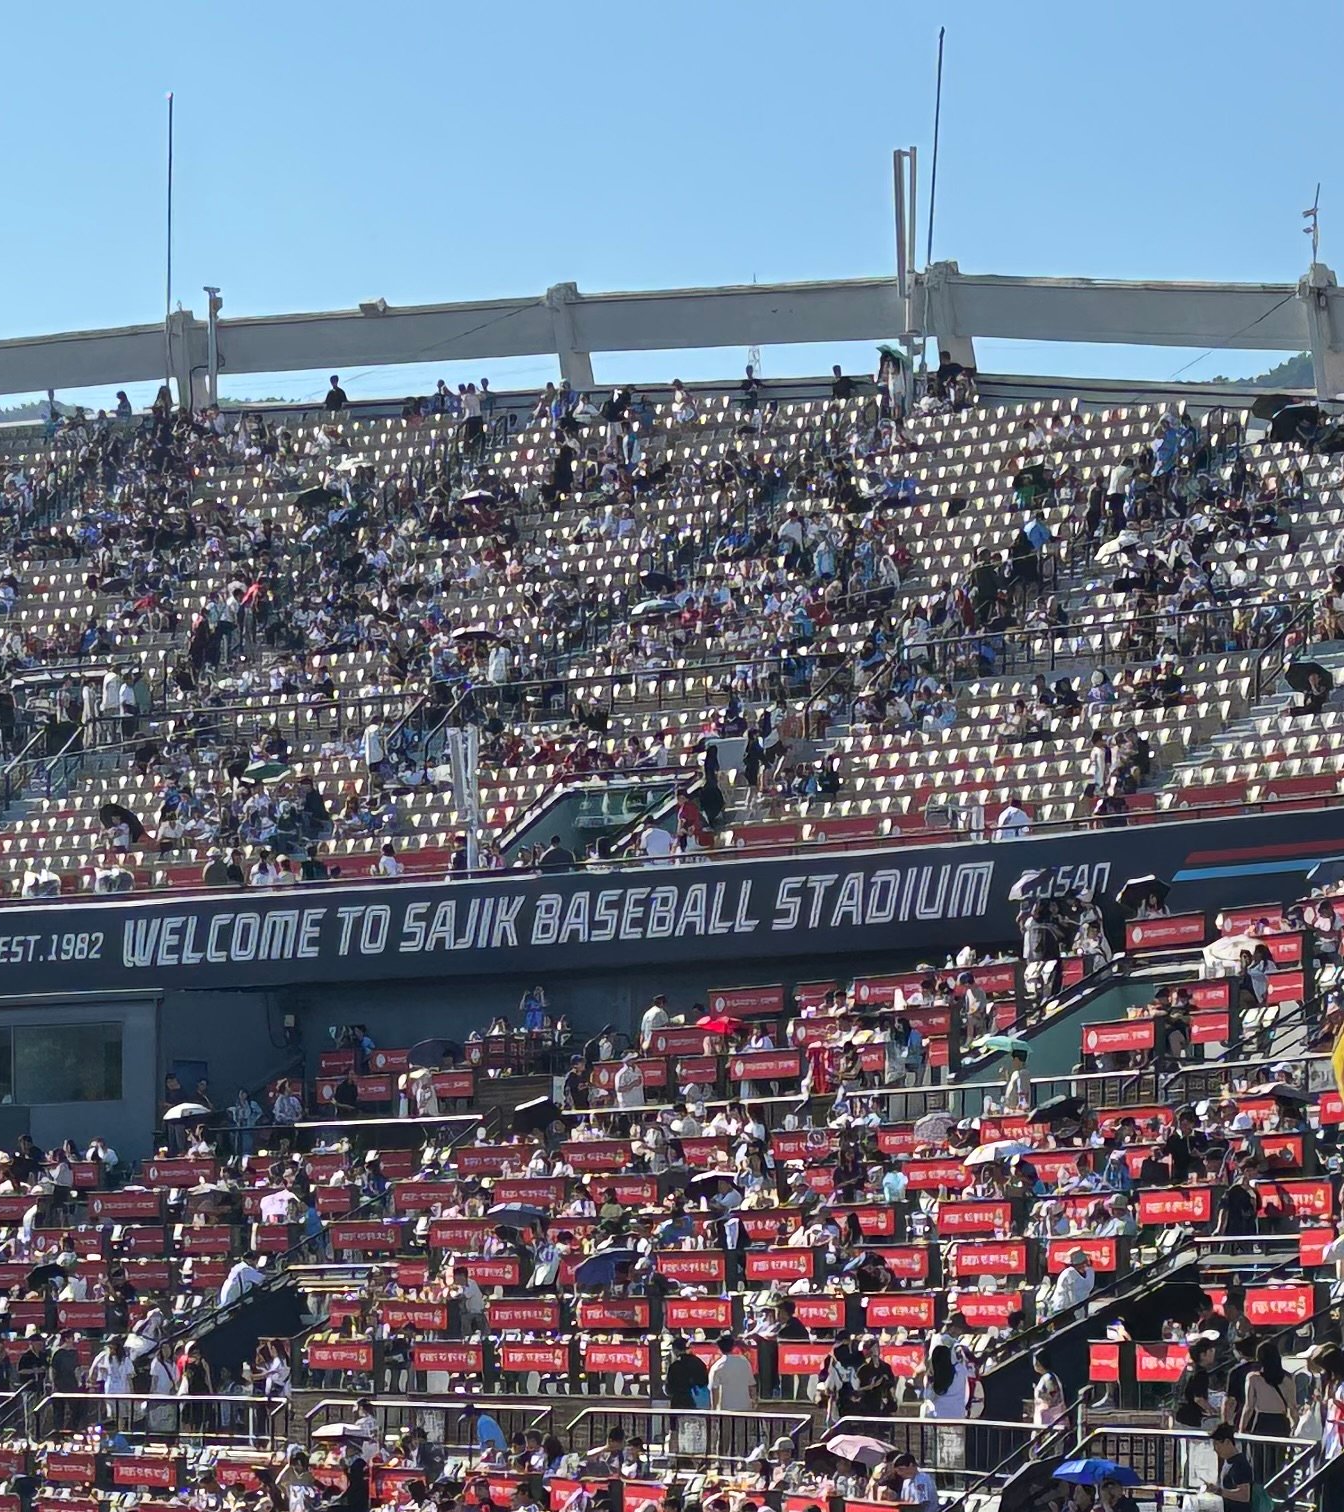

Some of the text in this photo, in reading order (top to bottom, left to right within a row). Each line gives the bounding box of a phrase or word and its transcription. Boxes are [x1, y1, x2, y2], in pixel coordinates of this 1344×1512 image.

[123, 907, 327, 967] WELCOME
[337, 905, 390, 955] TO
[399, 896, 526, 952] SAJIK
[531, 878, 760, 945] BASEBALL
[771, 860, 995, 931] STADIUM
